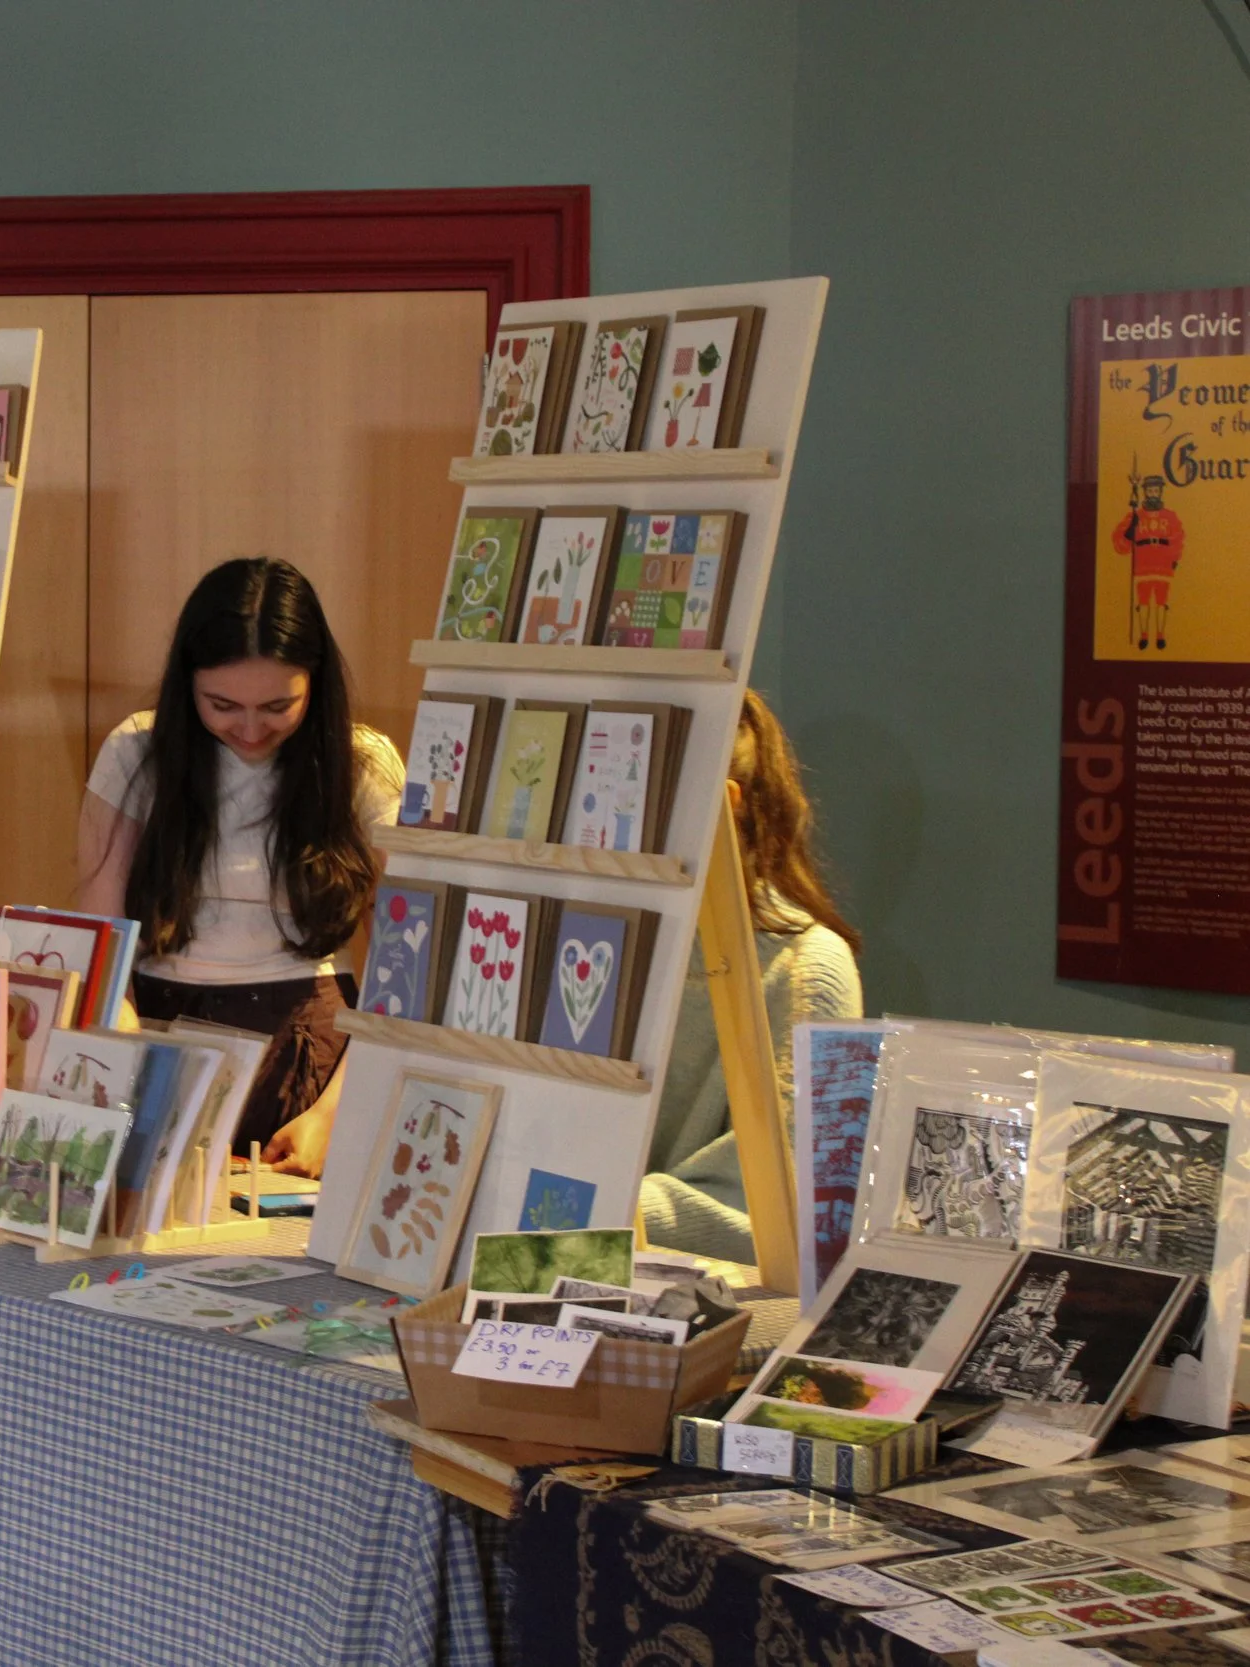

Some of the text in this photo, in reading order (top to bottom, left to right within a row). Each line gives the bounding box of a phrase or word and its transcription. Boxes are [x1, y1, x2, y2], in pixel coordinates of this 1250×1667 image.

[1103, 312, 1241, 342] Leeds Civic
[1109, 368, 1132, 391] the
[1211, 415, 1226, 437] of
[1138, 684, 1157, 696] The
[1158, 685, 1187, 697] Leeds
[1189, 686, 1231, 698] Institute
[1232, 686, 1244, 698] of
[1217, 702, 1244, 714] 1939
[1137, 715, 1166, 727] Leeds
[1168, 716, 1187, 731] City
[1137, 730, 1165, 742] taken
[1166, 733, 1187, 743] over
[1190, 732, 1202, 746] by
[1205, 732, 1222, 744] the
[1136, 745, 1155, 757] had
[1156, 747, 1168, 761] by
[1136, 761, 1179, 773] renamed
[1181, 762, 1198, 774] the
[1058, 698, 1125, 944] Leeds
[478, 1322, 595, 1344] DRY POINTS
[495, 1356, 510, 1371] 3
